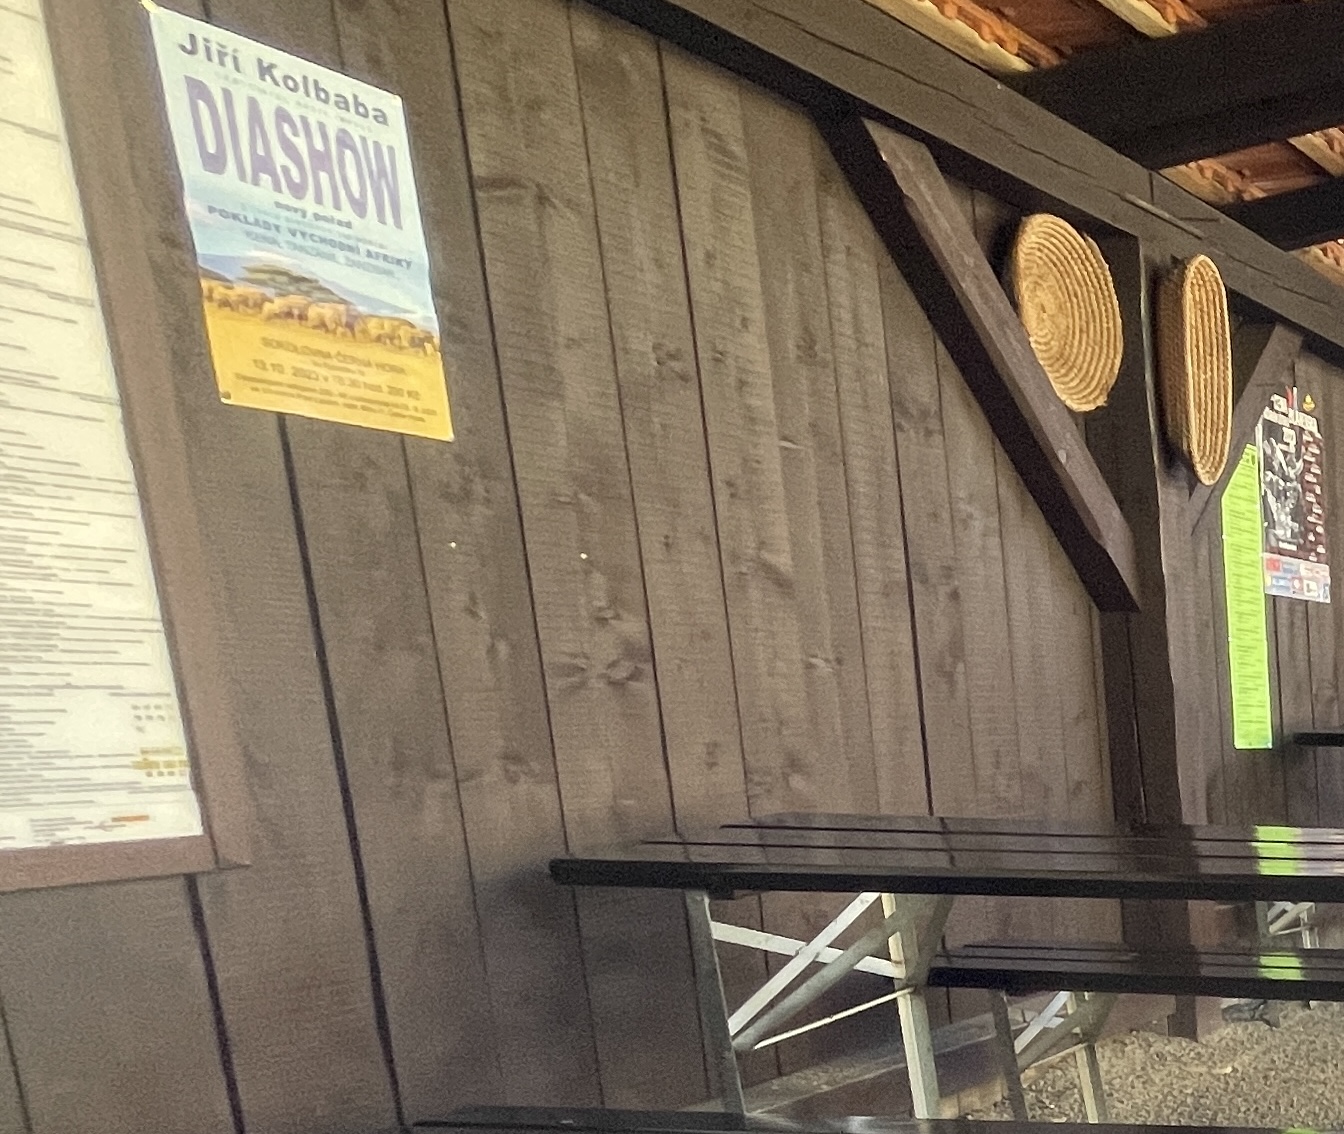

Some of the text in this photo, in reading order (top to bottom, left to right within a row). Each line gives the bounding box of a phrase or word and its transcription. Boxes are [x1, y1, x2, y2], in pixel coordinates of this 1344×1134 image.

[178, 33, 389, 126] Jiří Kolbaba
[184, 75, 404, 230] DIASHOW
